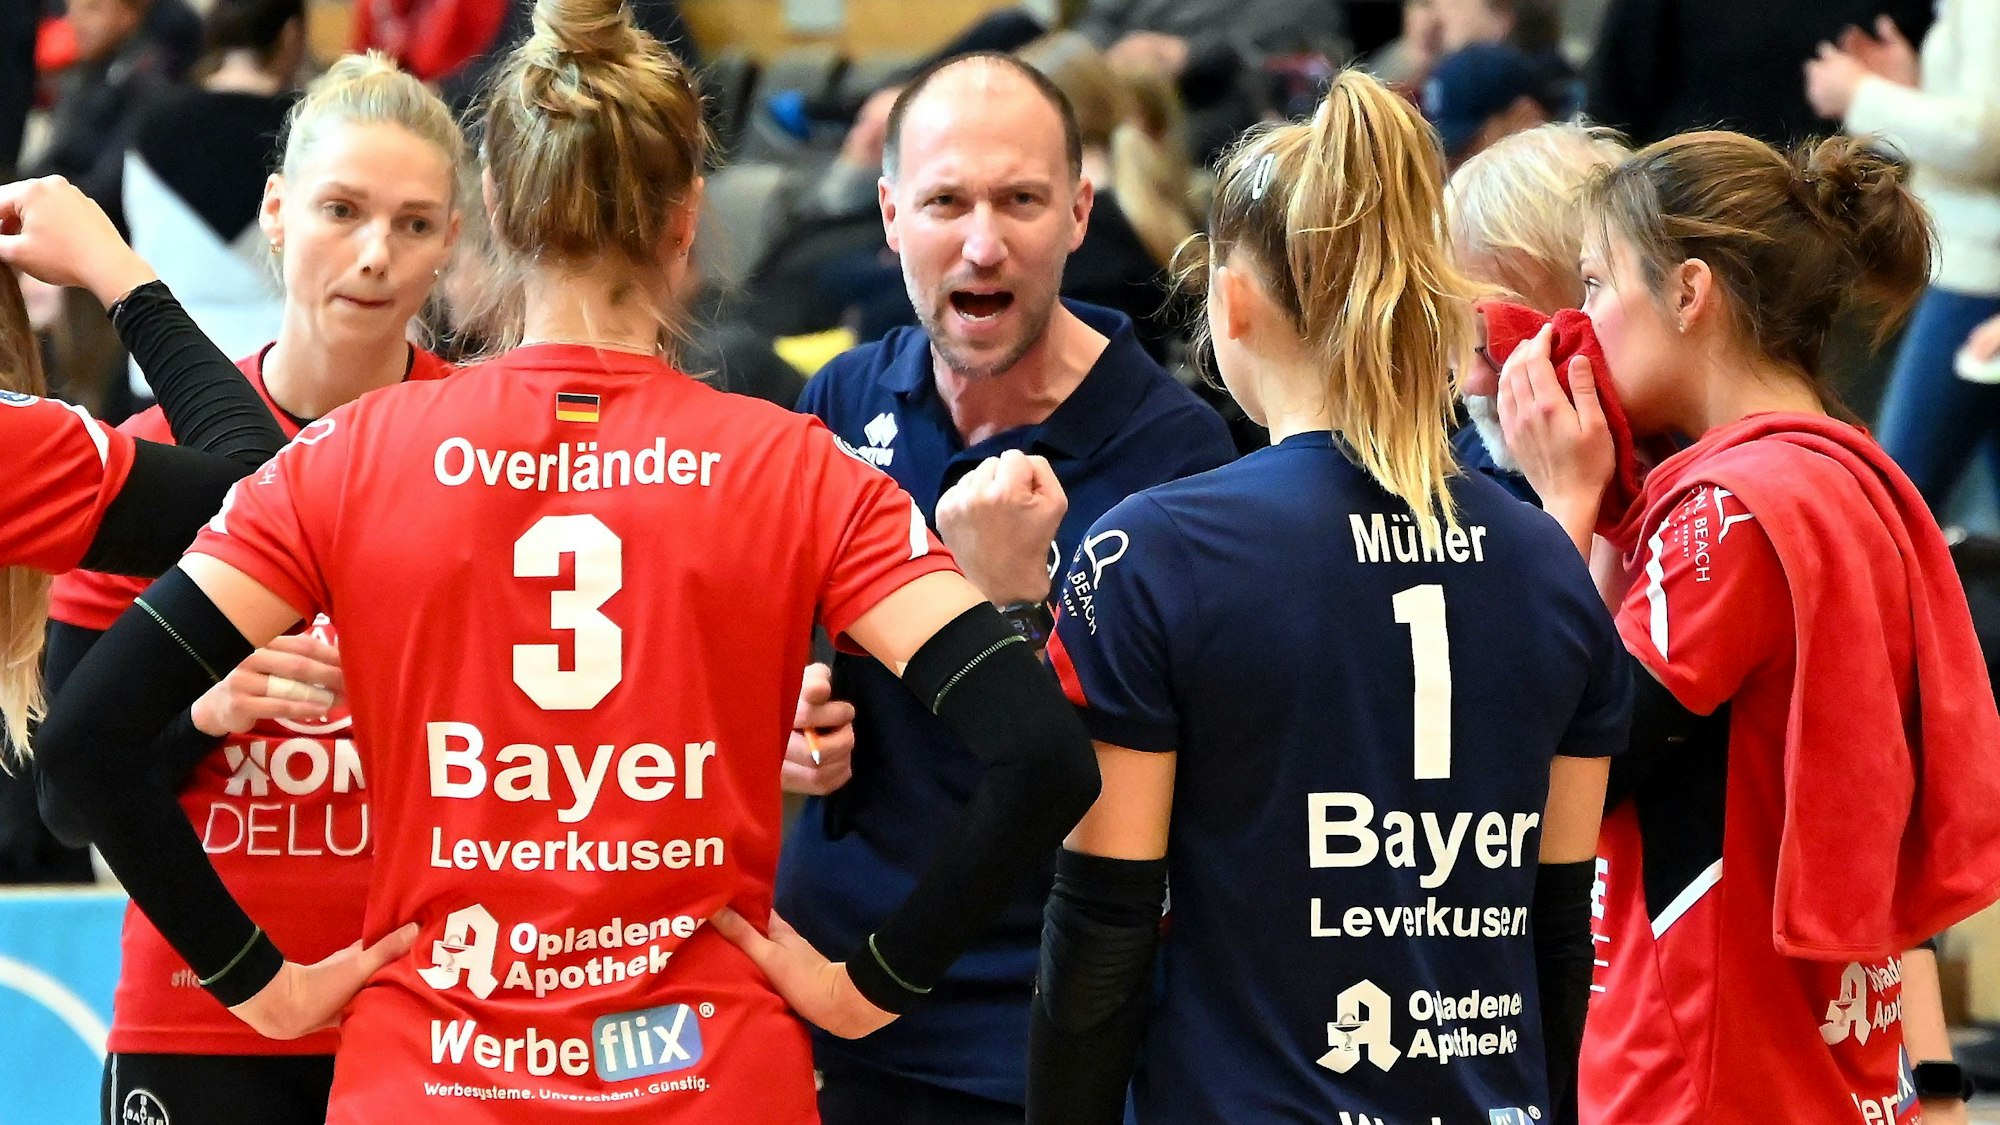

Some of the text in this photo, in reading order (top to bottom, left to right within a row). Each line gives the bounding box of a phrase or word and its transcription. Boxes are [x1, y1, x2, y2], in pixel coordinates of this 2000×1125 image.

[433, 436, 721, 492] Overländer
[1694, 516, 1710, 582] BEACH
[512, 513, 623, 711] 3
[1392, 583, 1452, 780] 1
[426, 721, 716, 823] Bayer
[202, 803, 368, 856] DELU
[430, 826, 724, 872] Leverkusen
[1307, 792, 1540, 889] Bayer
[1310, 897, 1527, 937] Leverkusen
[503, 944, 673, 998] Apothek
[424, 1081, 535, 1100] Werbesysteme.
[648, 1075, 710, 1095] Günstig.
